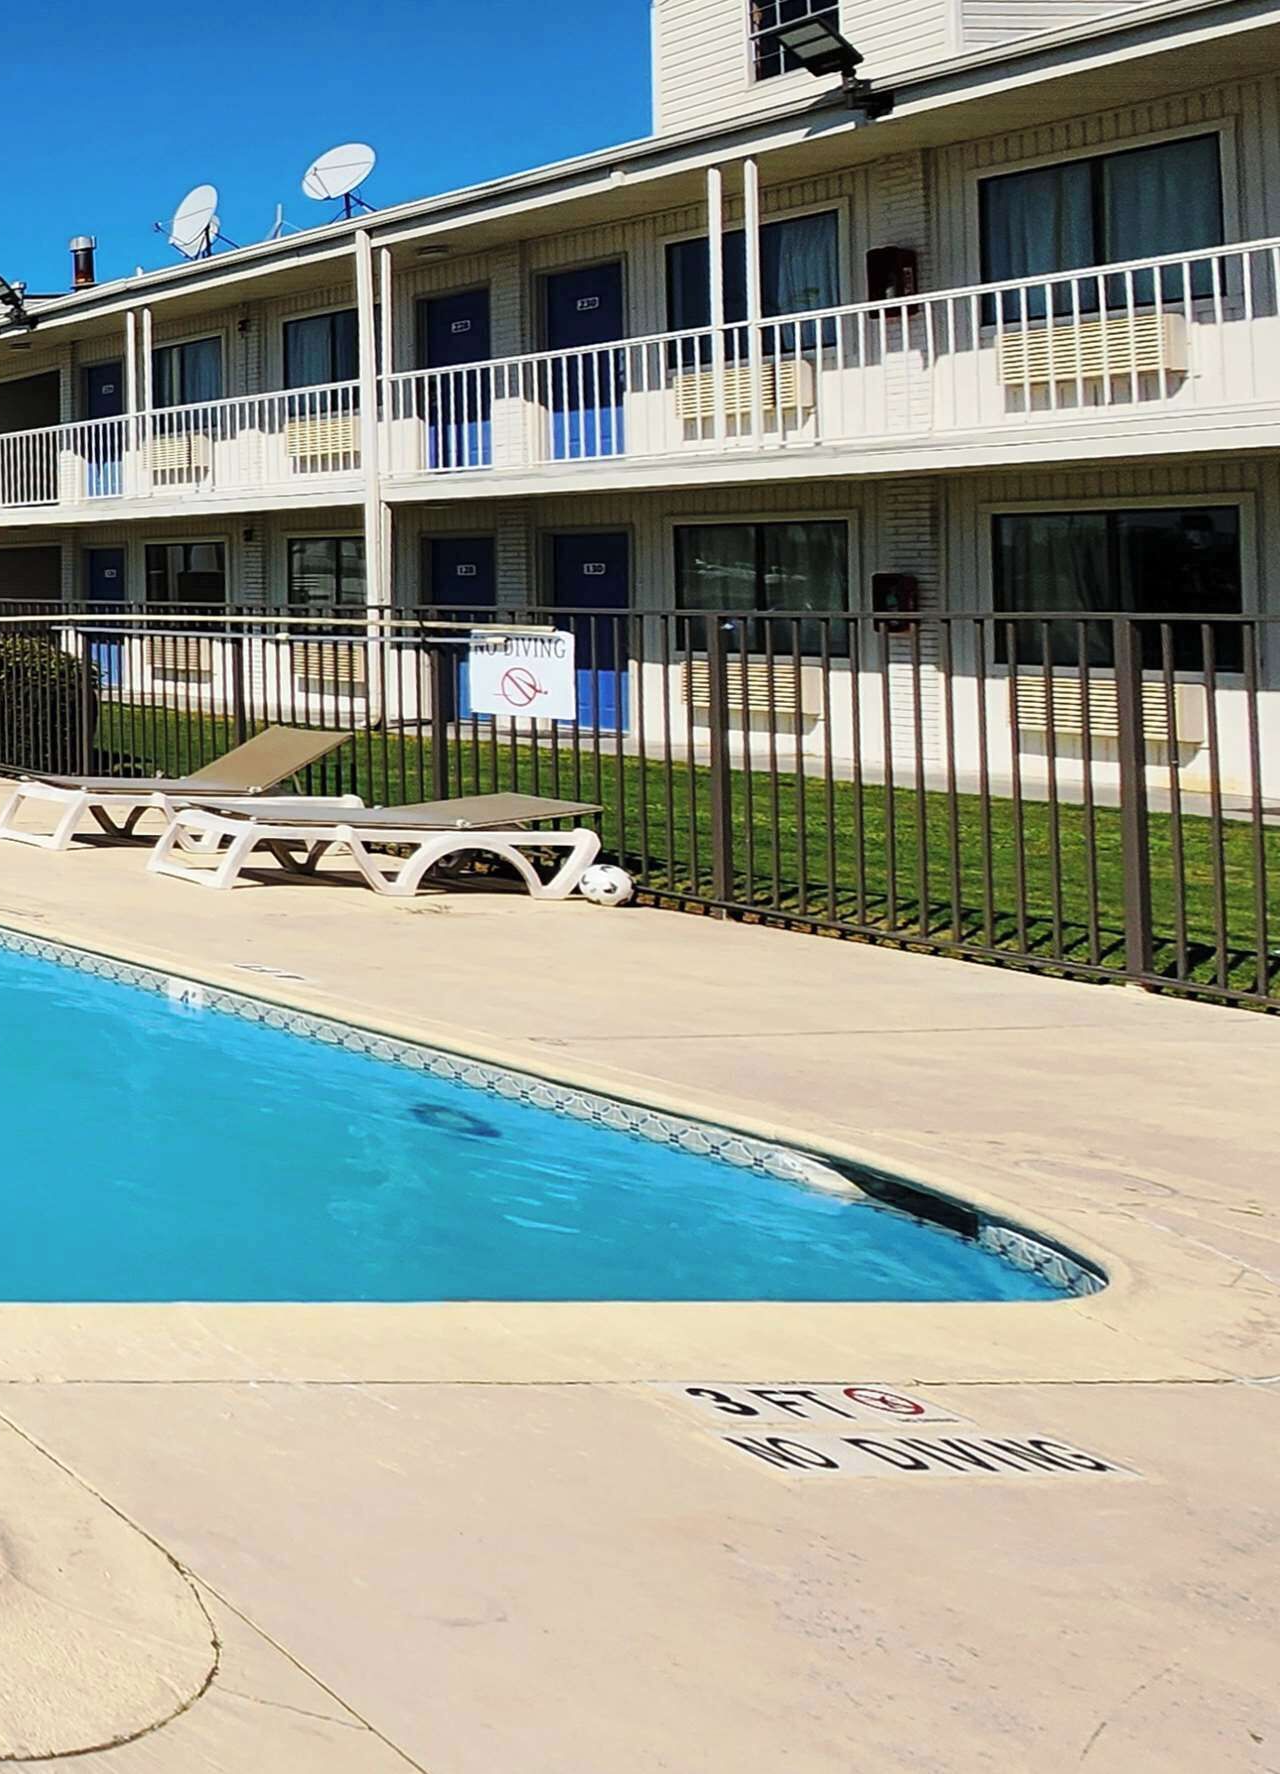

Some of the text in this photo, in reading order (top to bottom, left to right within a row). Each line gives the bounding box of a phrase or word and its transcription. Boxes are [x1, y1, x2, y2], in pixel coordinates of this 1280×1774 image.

[503, 637, 565, 658] DIVING
[685, 1387, 857, 1419] 3 FT
[721, 1436, 1115, 1473] NO DIVING
